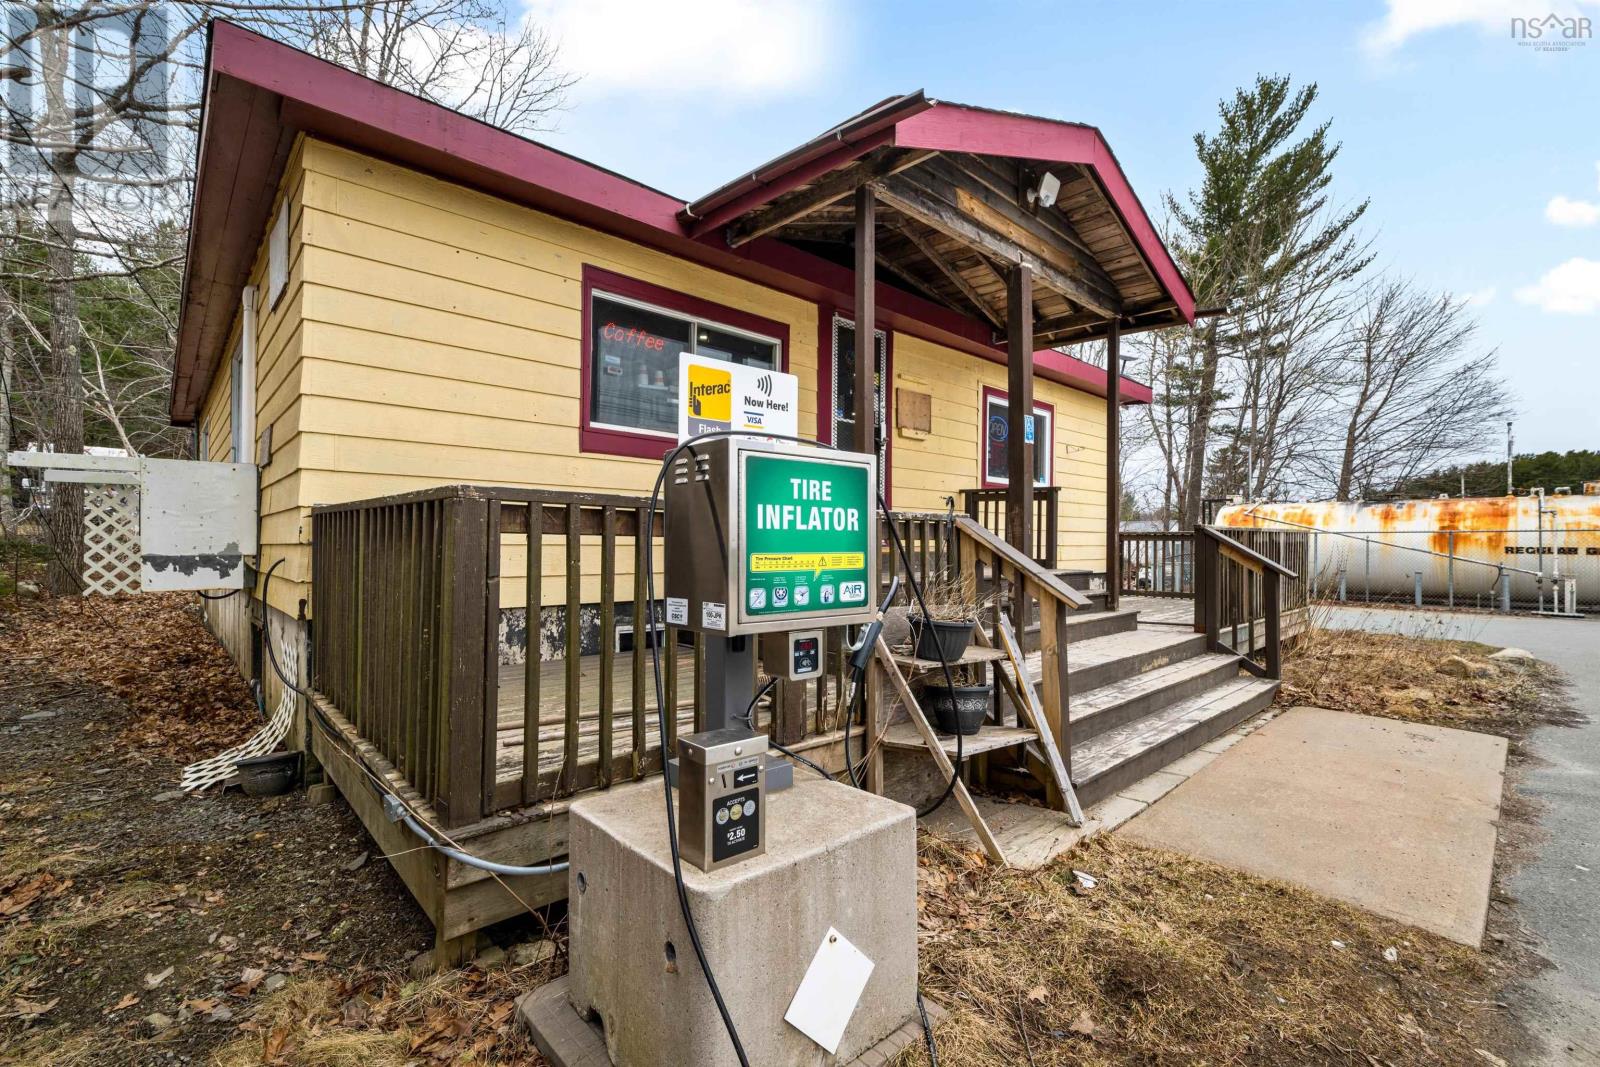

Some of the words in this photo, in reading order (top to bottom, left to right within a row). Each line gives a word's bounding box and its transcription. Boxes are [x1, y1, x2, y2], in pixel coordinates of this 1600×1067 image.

[603, 321, 665, 351] Coffee
[689, 381, 731, 397] Interac
[744, 396, 764, 408] Now
[766, 400, 789, 412] Here!
[746, 416, 762, 425] VISA
[790, 478, 832, 501] TIRE
[757, 504, 859, 531] INFLATOR
[1504, 546, 1578, 555] REGULAR
[1585, 547, 1600, 555] G
[727, 796, 745, 806] ACCEPTS
[727, 828, 746, 841] $2.50
